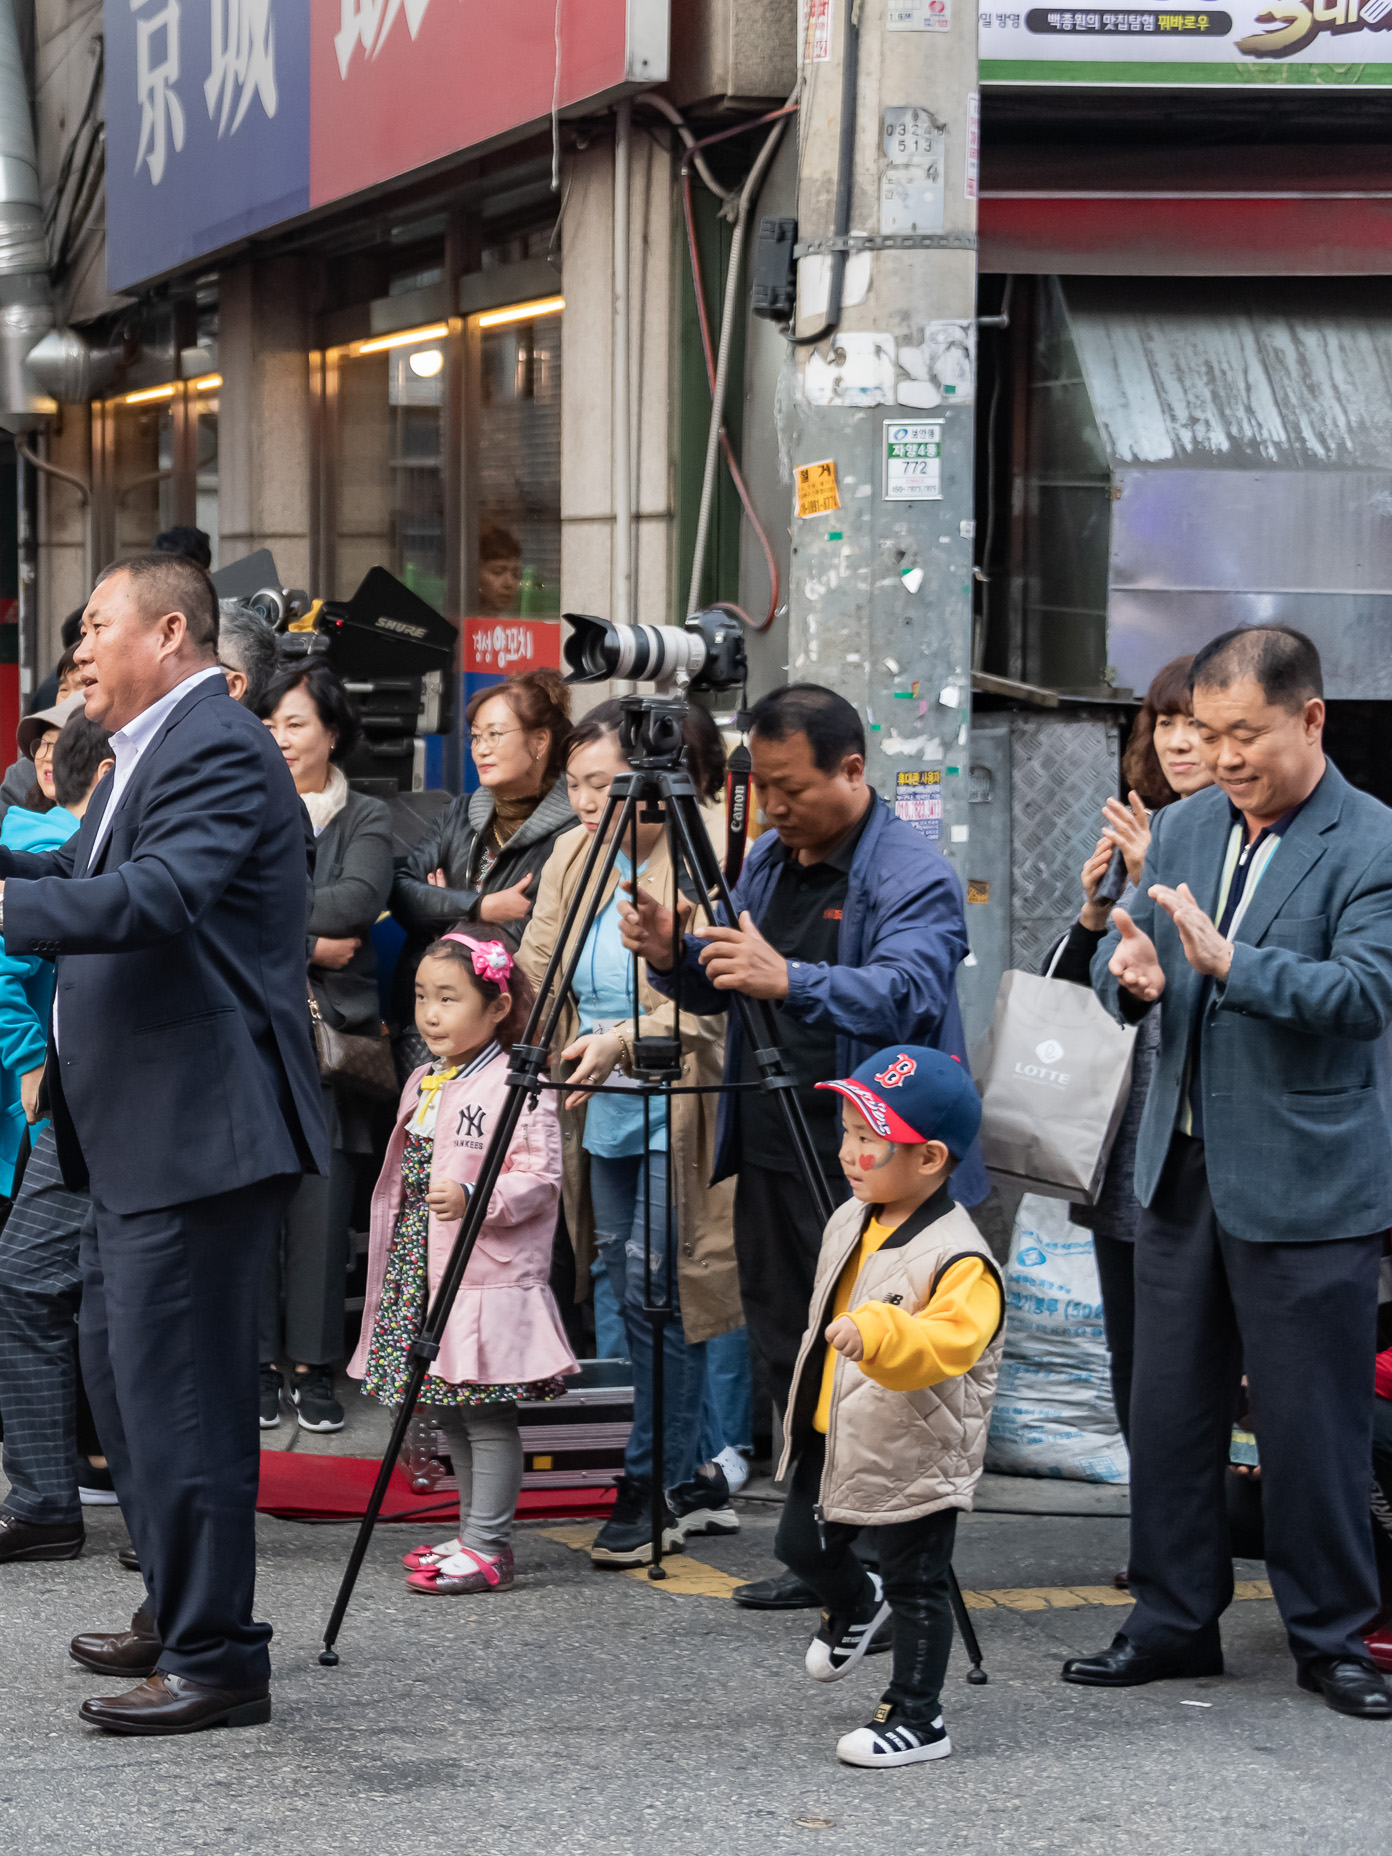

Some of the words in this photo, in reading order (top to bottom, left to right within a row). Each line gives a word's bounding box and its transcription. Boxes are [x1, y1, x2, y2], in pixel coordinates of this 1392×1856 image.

[1046, 11, 1101, 33] 백종원의
[1102, 14, 1155, 33] 맛집탐험
[897, 139, 933, 153] 513
[892, 442, 938, 458] 자양4동
[901, 460, 928, 475] 772
[373, 615, 429, 639] SHURE
[730, 784, 745, 833] Canon
[1013, 1061, 1071, 1086] LOTTE
[454, 1139, 484, 1150] YANKEES
